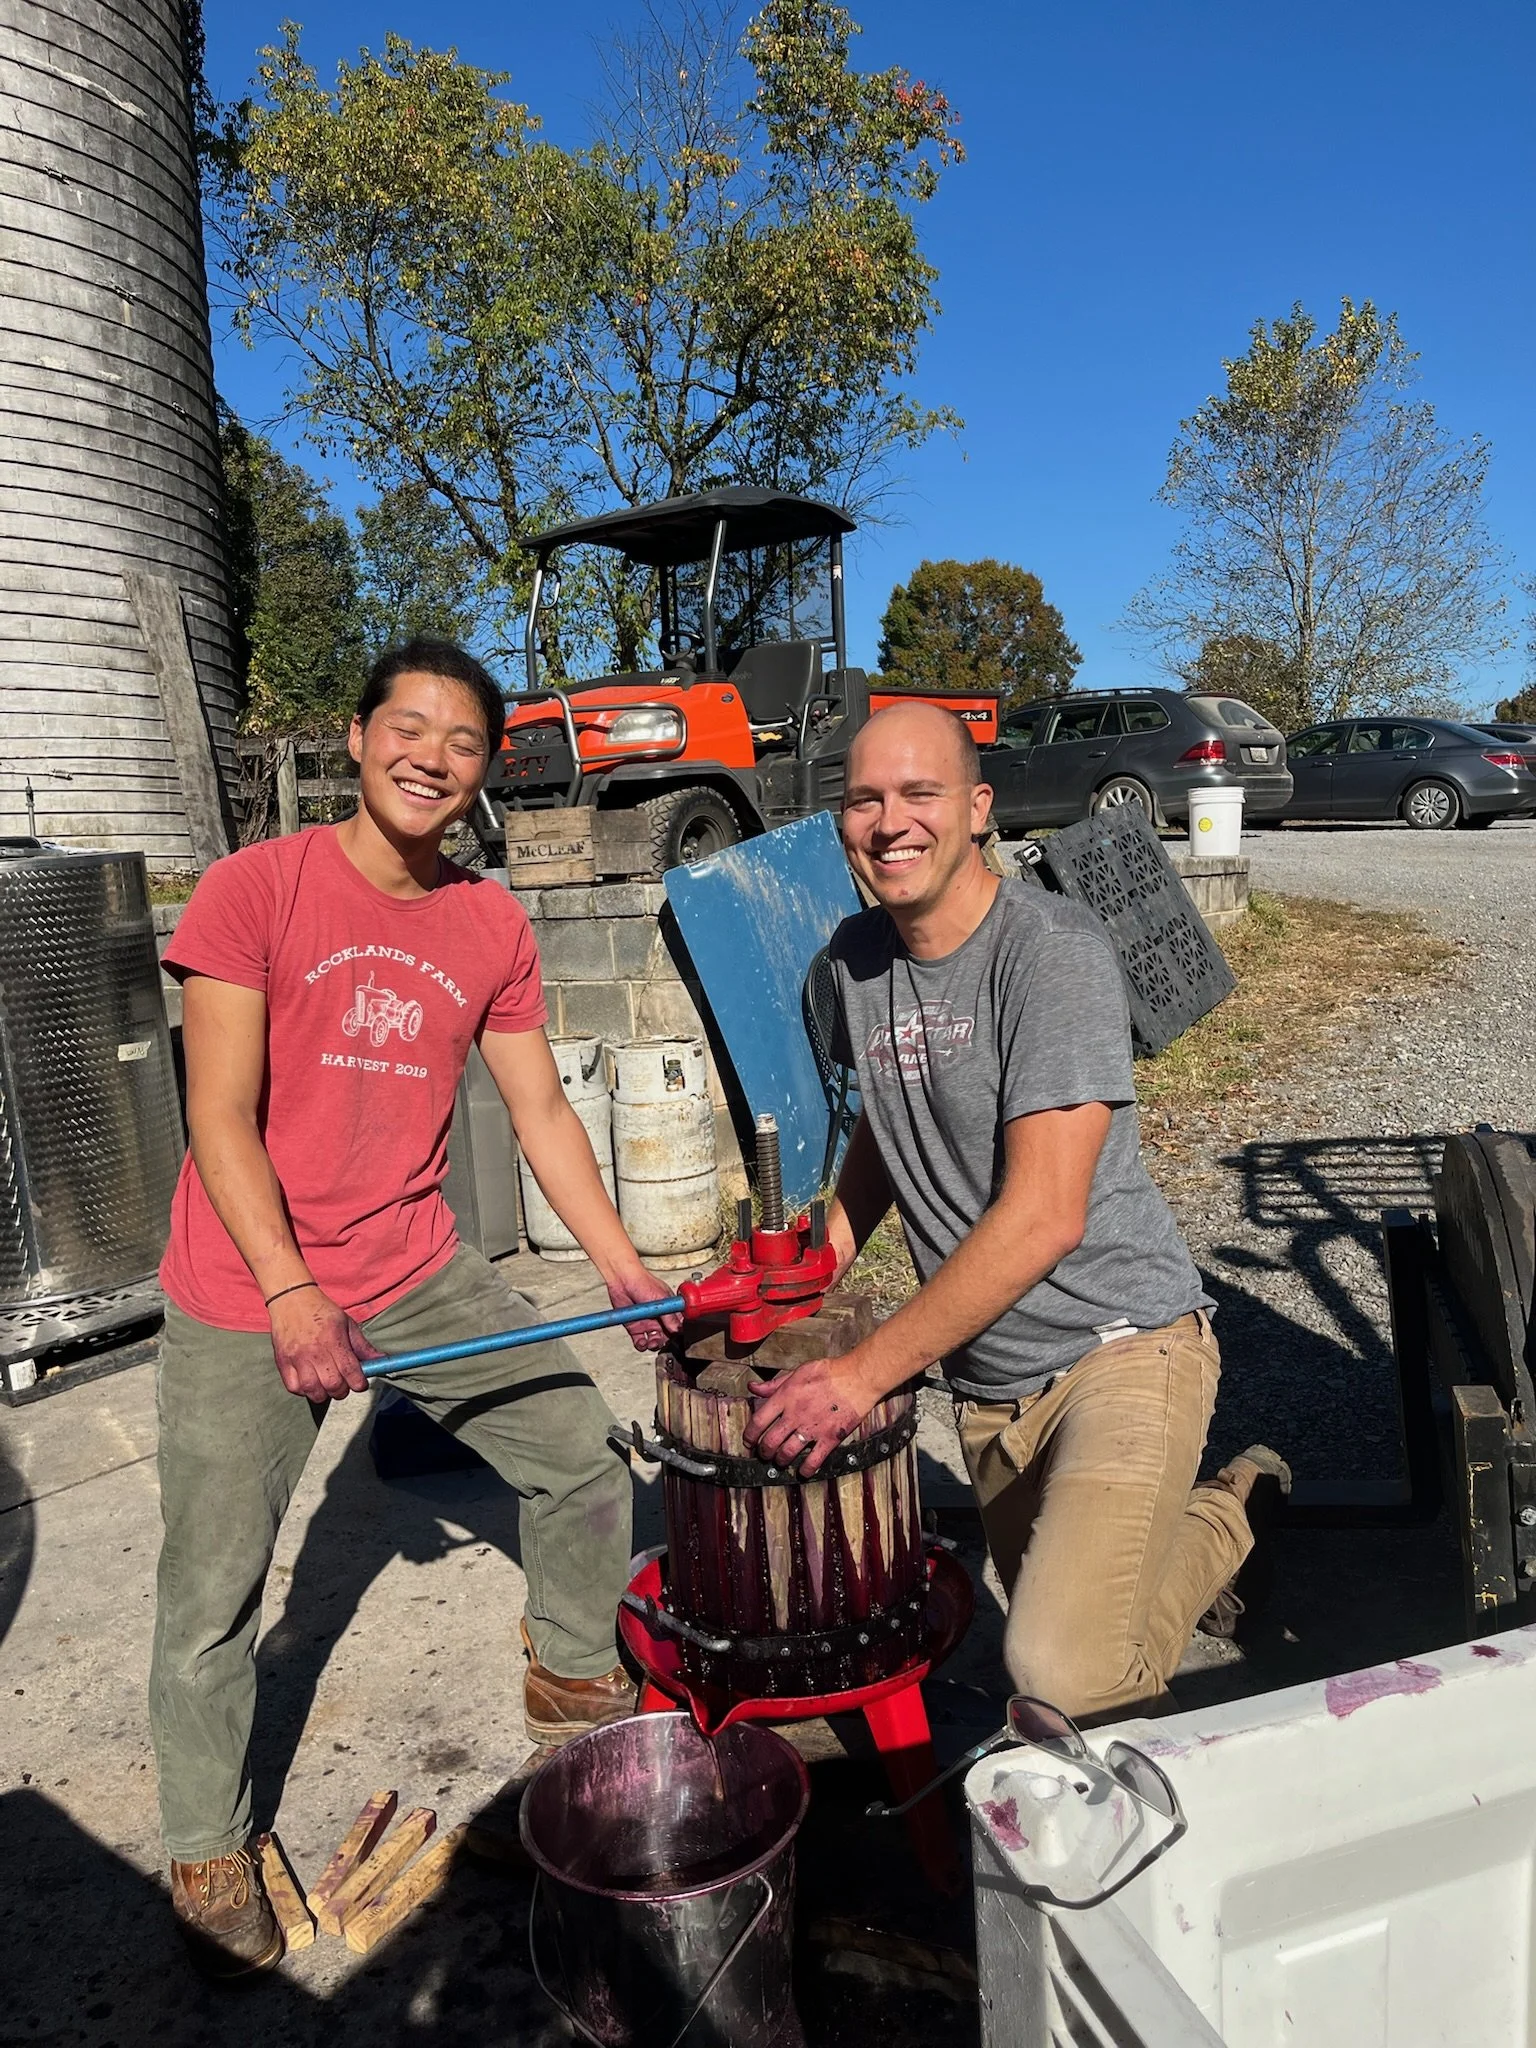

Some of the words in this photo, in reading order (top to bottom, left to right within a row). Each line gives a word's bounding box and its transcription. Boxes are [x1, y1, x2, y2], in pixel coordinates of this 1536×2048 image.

[960, 711, 988, 721] 4x4
[500, 755, 551, 778] RTV
[304, 945, 416, 985] ROCKLANDS
[419, 960, 468, 1008] FARM
[320, 1053, 390, 1073] HARVEST
[394, 1062, 428, 1079] 2019
